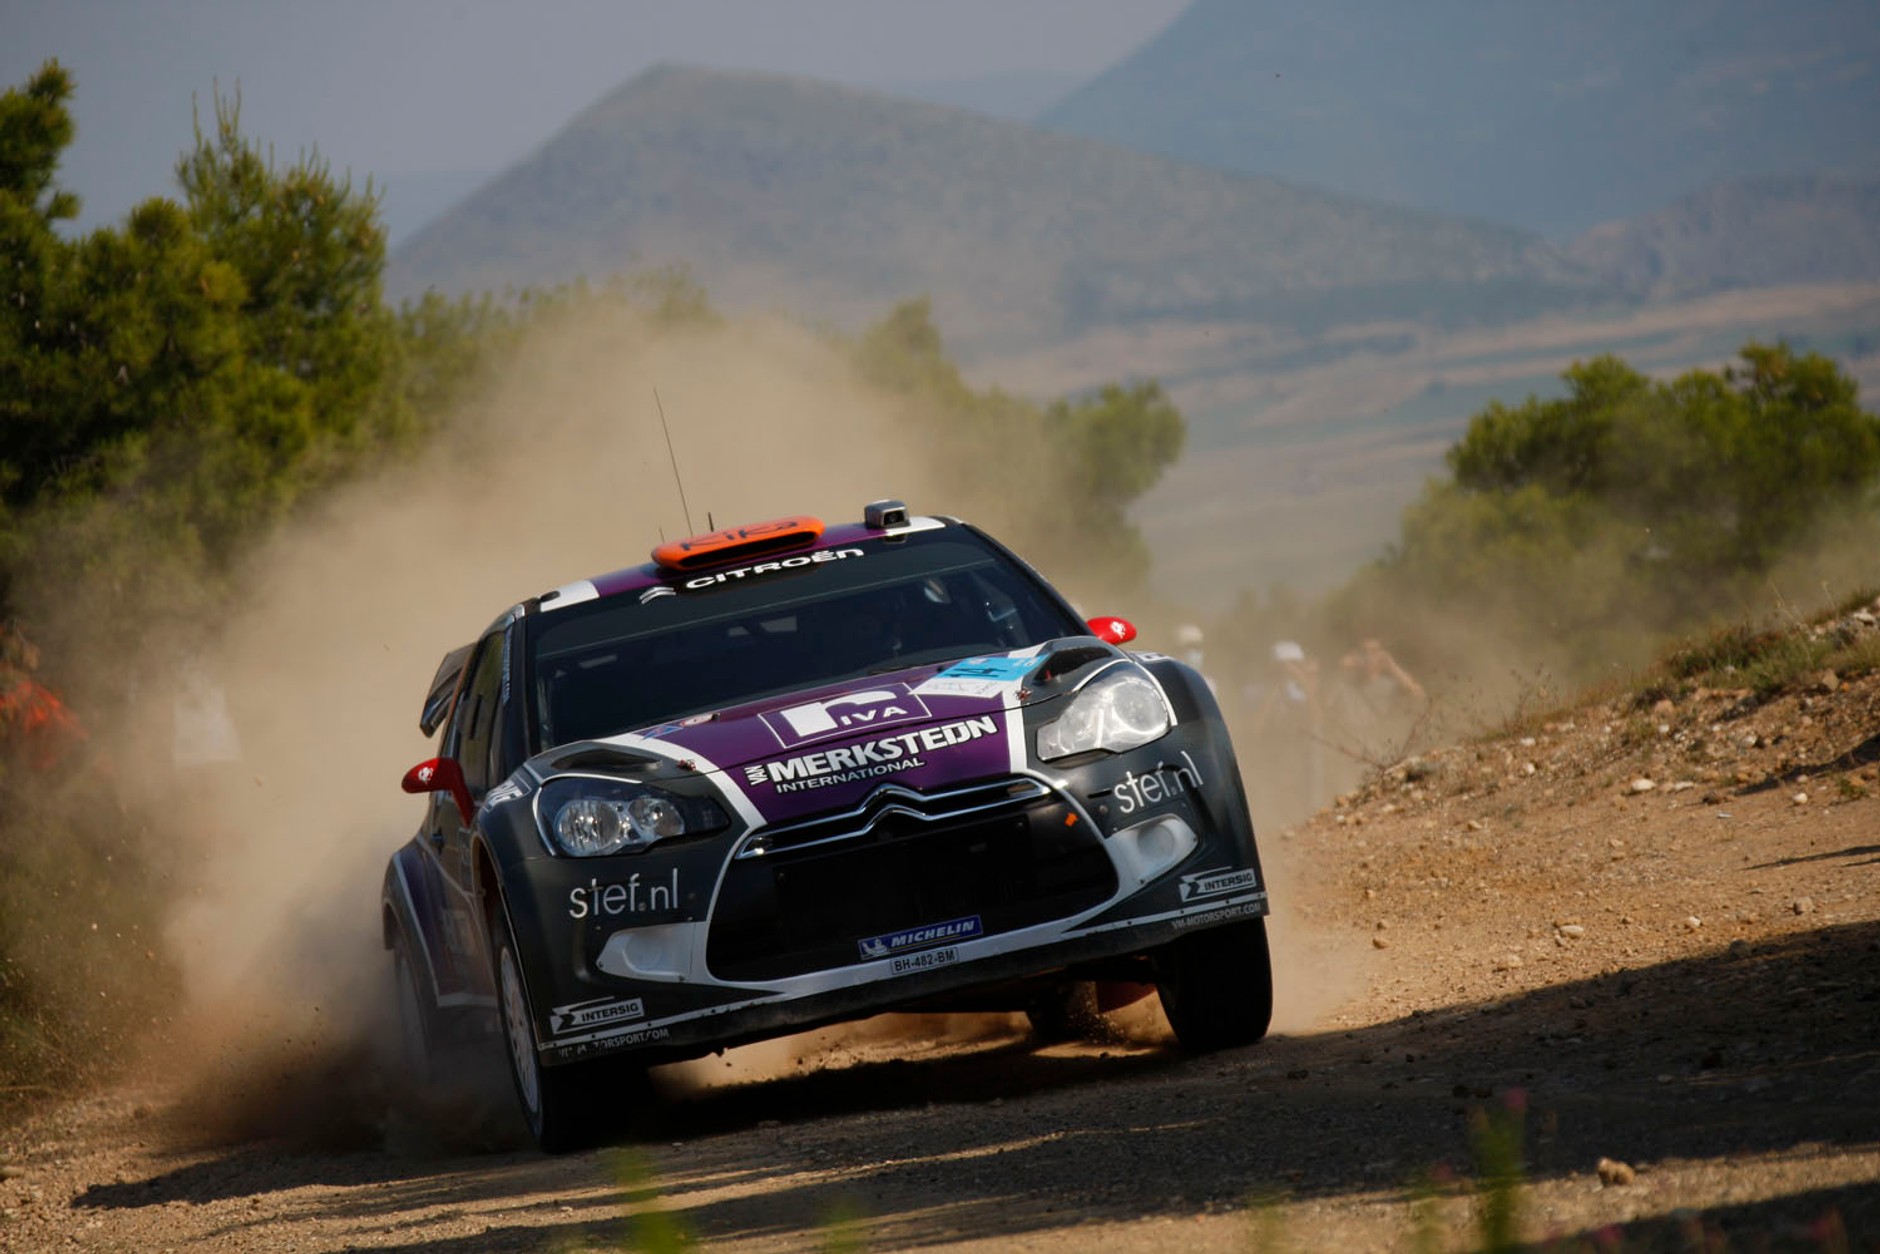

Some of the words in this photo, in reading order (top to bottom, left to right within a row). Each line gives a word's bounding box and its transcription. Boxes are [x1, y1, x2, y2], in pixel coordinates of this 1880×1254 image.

[775, 756, 926, 794] INTERNATIONAL
[568, 867, 679, 919] stef.nl
[891, 920, 975, 948] MICHELIN
[894, 949, 956, 972] BH-482-BM
[581, 1002, 640, 1023] INTERSIG
